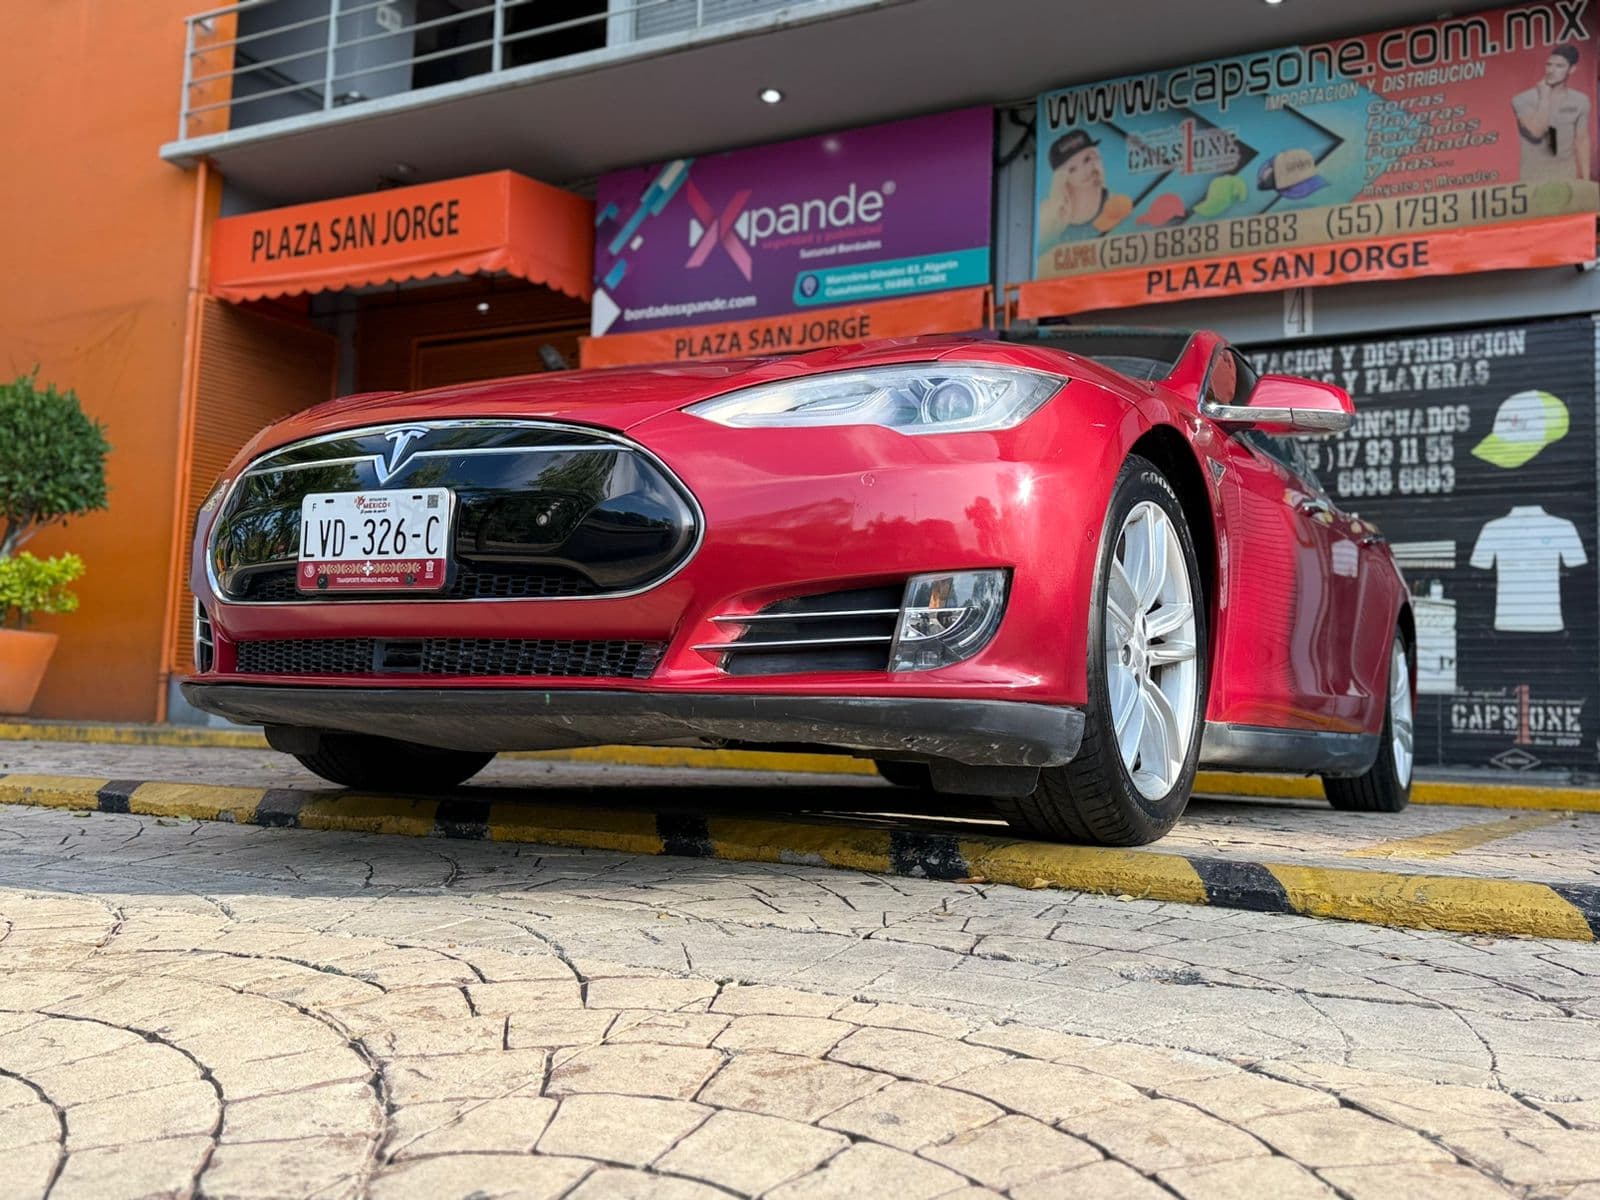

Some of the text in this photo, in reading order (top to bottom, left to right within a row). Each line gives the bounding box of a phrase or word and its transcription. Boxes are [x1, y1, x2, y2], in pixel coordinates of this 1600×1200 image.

[1046, 1, 1588, 129] www.capsone.com.mx
[1366, 79, 1376, 94] Y
[1367, 92, 1445, 114] Gorras
[1367, 105, 1467, 130] Playeras
[1367, 131, 1499, 160] Ponchados
[1366, 164, 1378, 178] y
[1424, 179, 1432, 192] y
[251, 199, 459, 263] PLAZA SAN JORGE
[1100, 235, 1147, 268] (55)
[1153, 223, 1219, 259] 6838
[1230, 213, 1297, 248] 6683
[1326, 204, 1383, 240] (55)
[1396, 193, 1458, 229] 1793
[1471, 184, 1528, 219] 1155
[1146, 240, 1429, 294] PLAZA SAN JORGE
[624, 295, 757, 321] bordadosxpande.com
[675, 315, 870, 359] PLAZA SAN JORGE
[1340, 345, 1356, 369] Y
[1363, 330, 1527, 368] DISTRIBUCION
[1342, 360, 1490, 395] Y PLAYERAS
[1365, 439, 1393, 465] 93
[1400, 438, 1418, 464] 11
[1425, 436, 1454, 463] 55
[1337, 466, 1455, 497] 6838 6683
[312, 503, 317, 511] F
[303, 516, 440, 557] LVD-326-C
